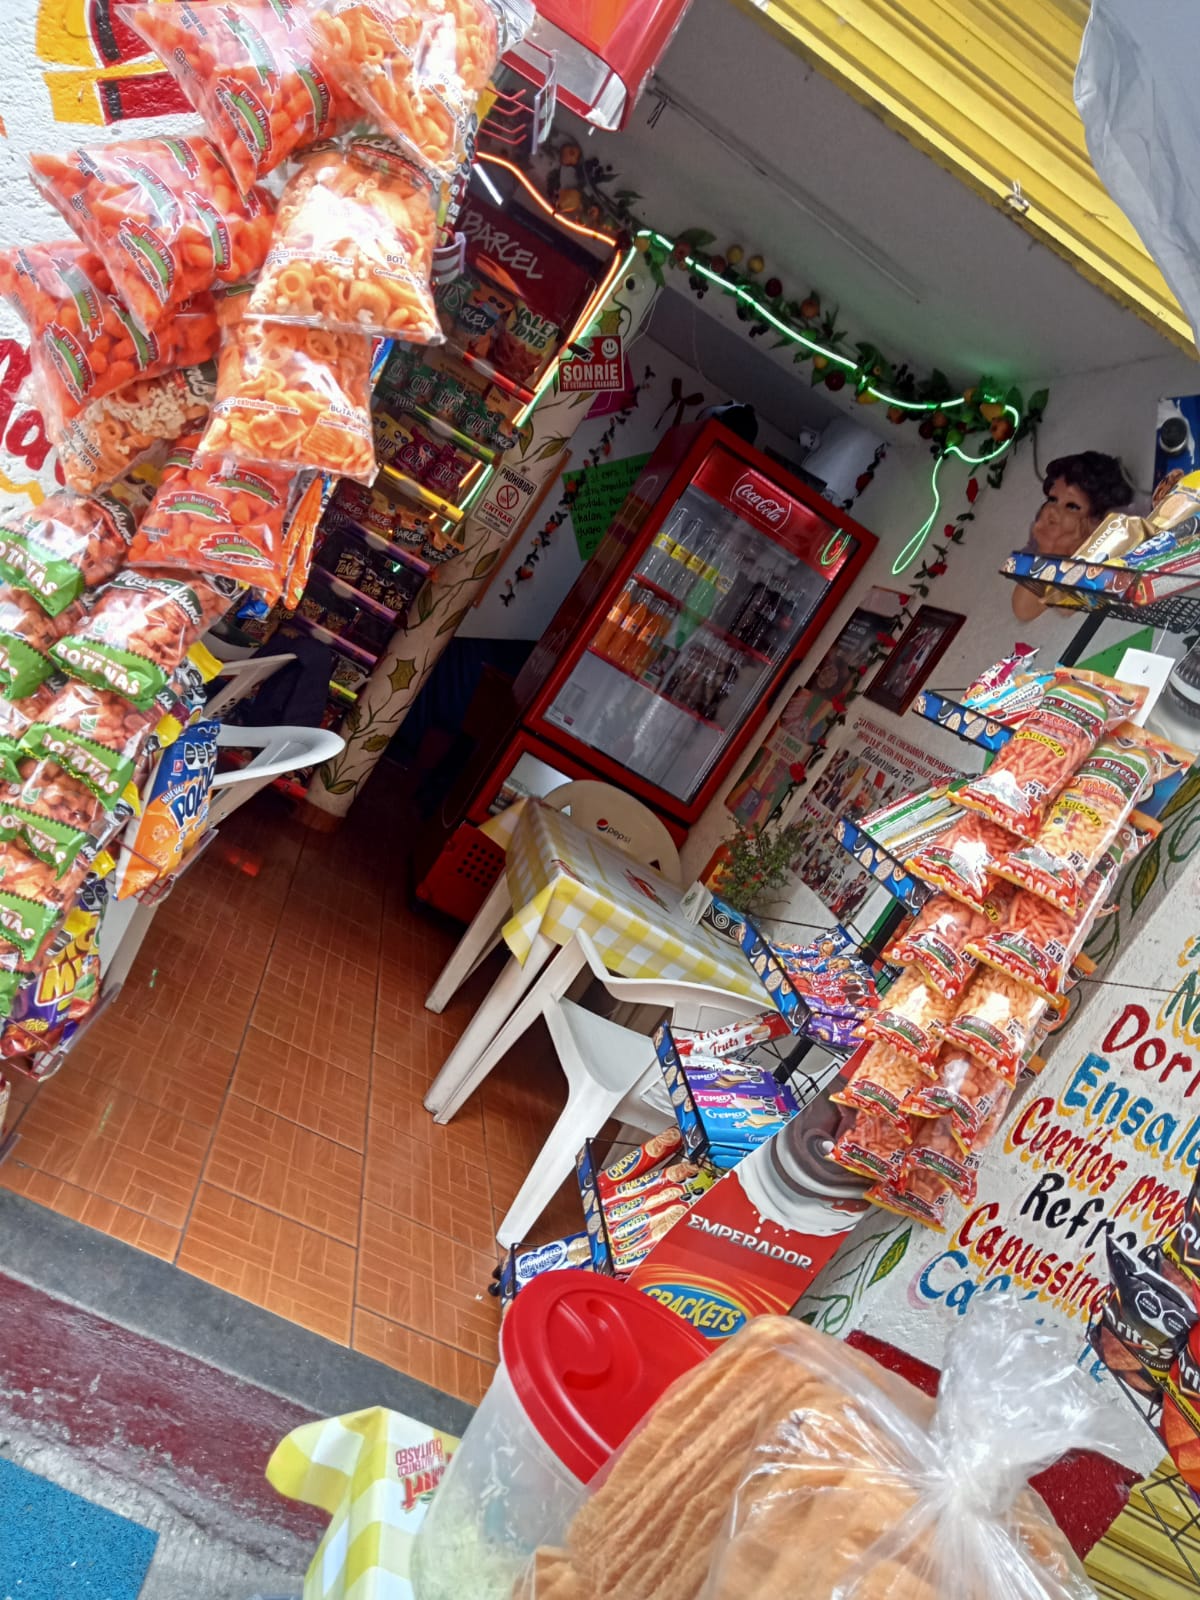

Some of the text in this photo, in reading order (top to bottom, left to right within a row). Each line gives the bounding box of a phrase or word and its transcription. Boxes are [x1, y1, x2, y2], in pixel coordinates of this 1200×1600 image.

[459, 209, 543, 280] BARCEL
[563, 360, 618, 381] SONRÍE
[71, 420, 92, 449] OTANA
[499, 468, 535, 497] PROHIBIDO
[482, 502, 514, 525] ENTRAR
[606, 825, 632, 844] pepsi
[704, 1108, 753, 1121] Cremax
[1012, 1097, 1128, 1192] Cueritos
[609, 1149, 641, 1178] CRACKETS
[687, 1212, 813, 1270] EMPERADOR
[646, 1287, 743, 1333] CRACKETS
